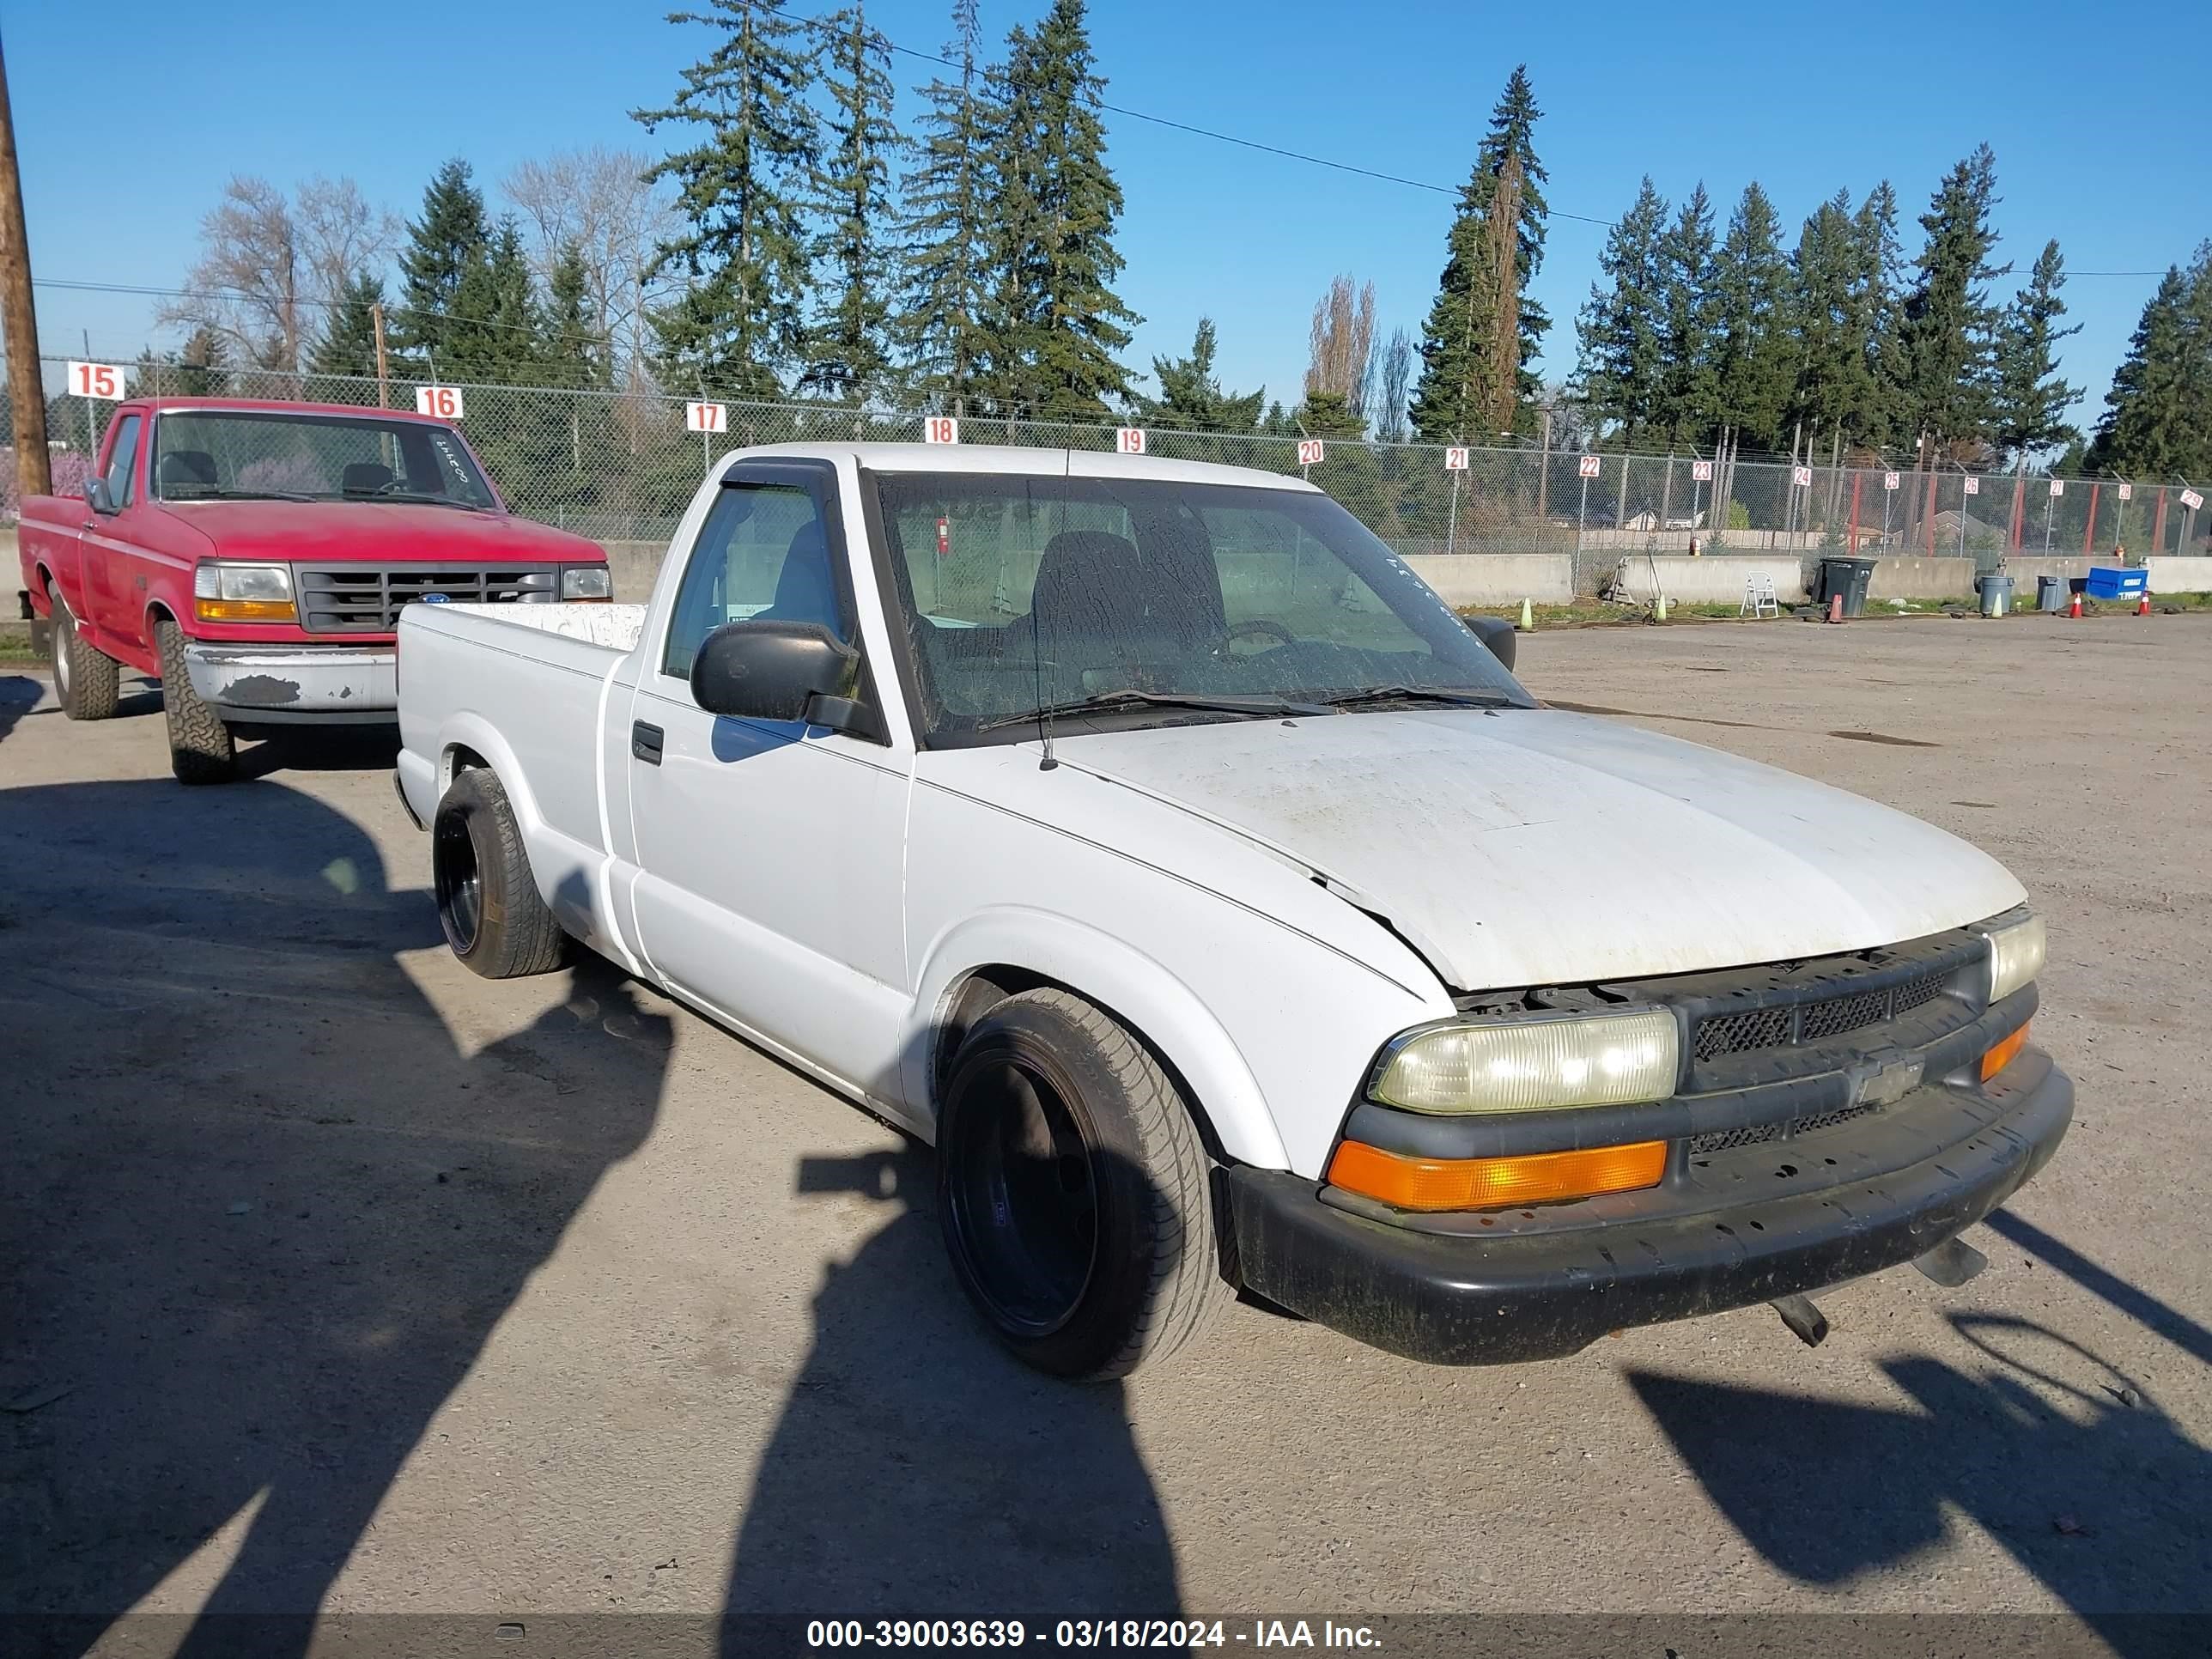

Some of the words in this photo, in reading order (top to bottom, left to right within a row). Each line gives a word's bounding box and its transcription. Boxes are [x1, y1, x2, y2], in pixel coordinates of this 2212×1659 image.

[79, 366, 114, 397] 15
[425, 390, 455, 416] 16
[696, 405, 718, 431] 17
[931, 419, 951, 443] 18
[1123, 430, 1141, 453] 19
[1300, 441, 1322, 463] 20
[1449, 449, 1465, 468] 21
[1581, 458, 1598, 476] 22
[1694, 462, 1710, 479] 23
[1796, 468, 1809, 485] 24
[1886, 473, 1898, 489] 25
[1966, 478, 1977, 493] 26
[2051, 481, 2062, 495] 27
[2120, 486, 2130, 499] 28
[2185, 491, 2201, 507] 29
